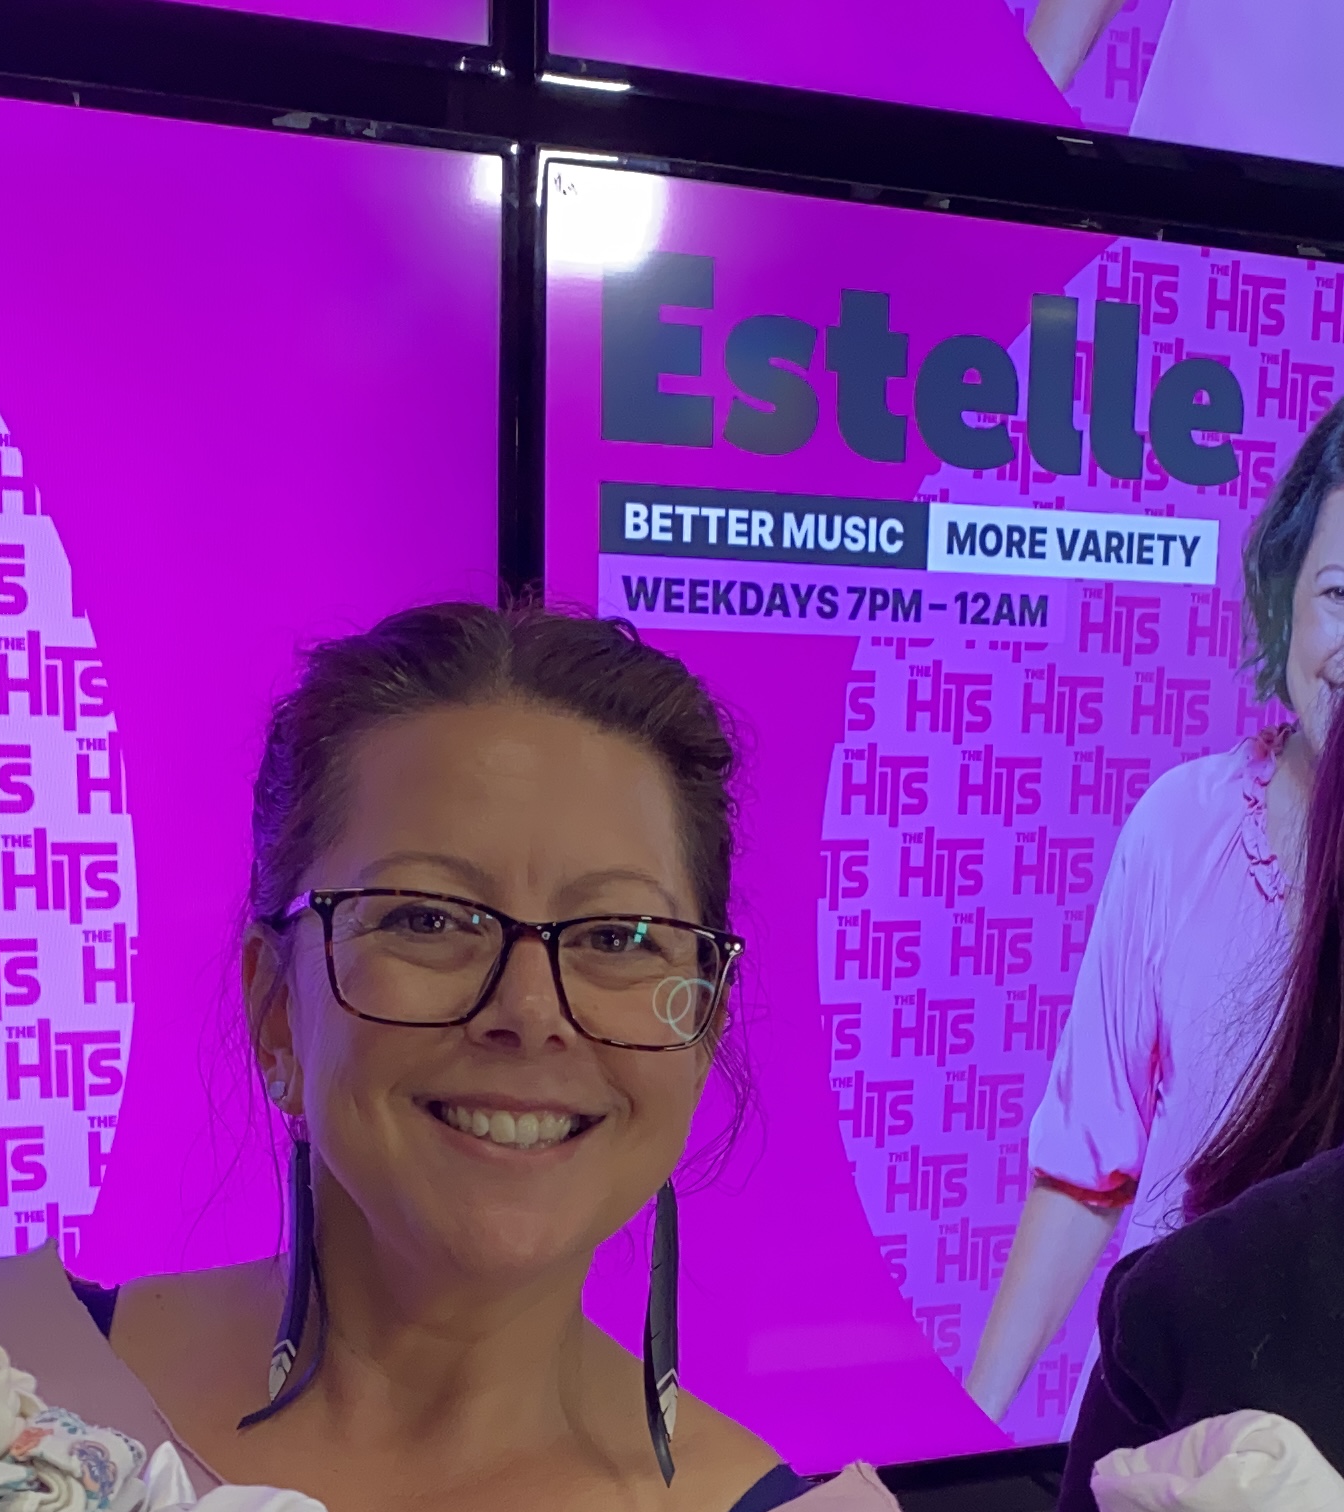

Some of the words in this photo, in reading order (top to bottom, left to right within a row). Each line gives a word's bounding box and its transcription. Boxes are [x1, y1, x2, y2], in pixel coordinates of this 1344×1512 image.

[1210, 264, 1229, 276] THE
[1316, 277, 1334, 288] THE
[1261, 353, 1279, 365] THE
[601, 253, 1245, 487] Estelle
[625, 502, 774, 547] BETTER
[782, 512, 904, 553] MUSIC
[946, 521, 1048, 559] MORE
[1057, 527, 1201, 568] VARIETY
[622, 575, 839, 620] WEEKDAYS
[846, 586, 923, 623] 7PM
[954, 591, 1048, 629] 12AM
[906, 664, 928, 676] THE
[1025, 669, 1044, 679] THE
[844, 749, 866, 760] THE
[961, 750, 982, 761] THE
[1, 835, 32, 848] THE
[899, 831, 921, 842] THE
[1016, 832, 1036, 842] THE
[838, 916, 859, 926] THE
[954, 913, 973, 923] THE
[895, 995, 915, 1005] THE
[6, 1026, 36, 1038] THE
[946, 1071, 965, 1081] THE
